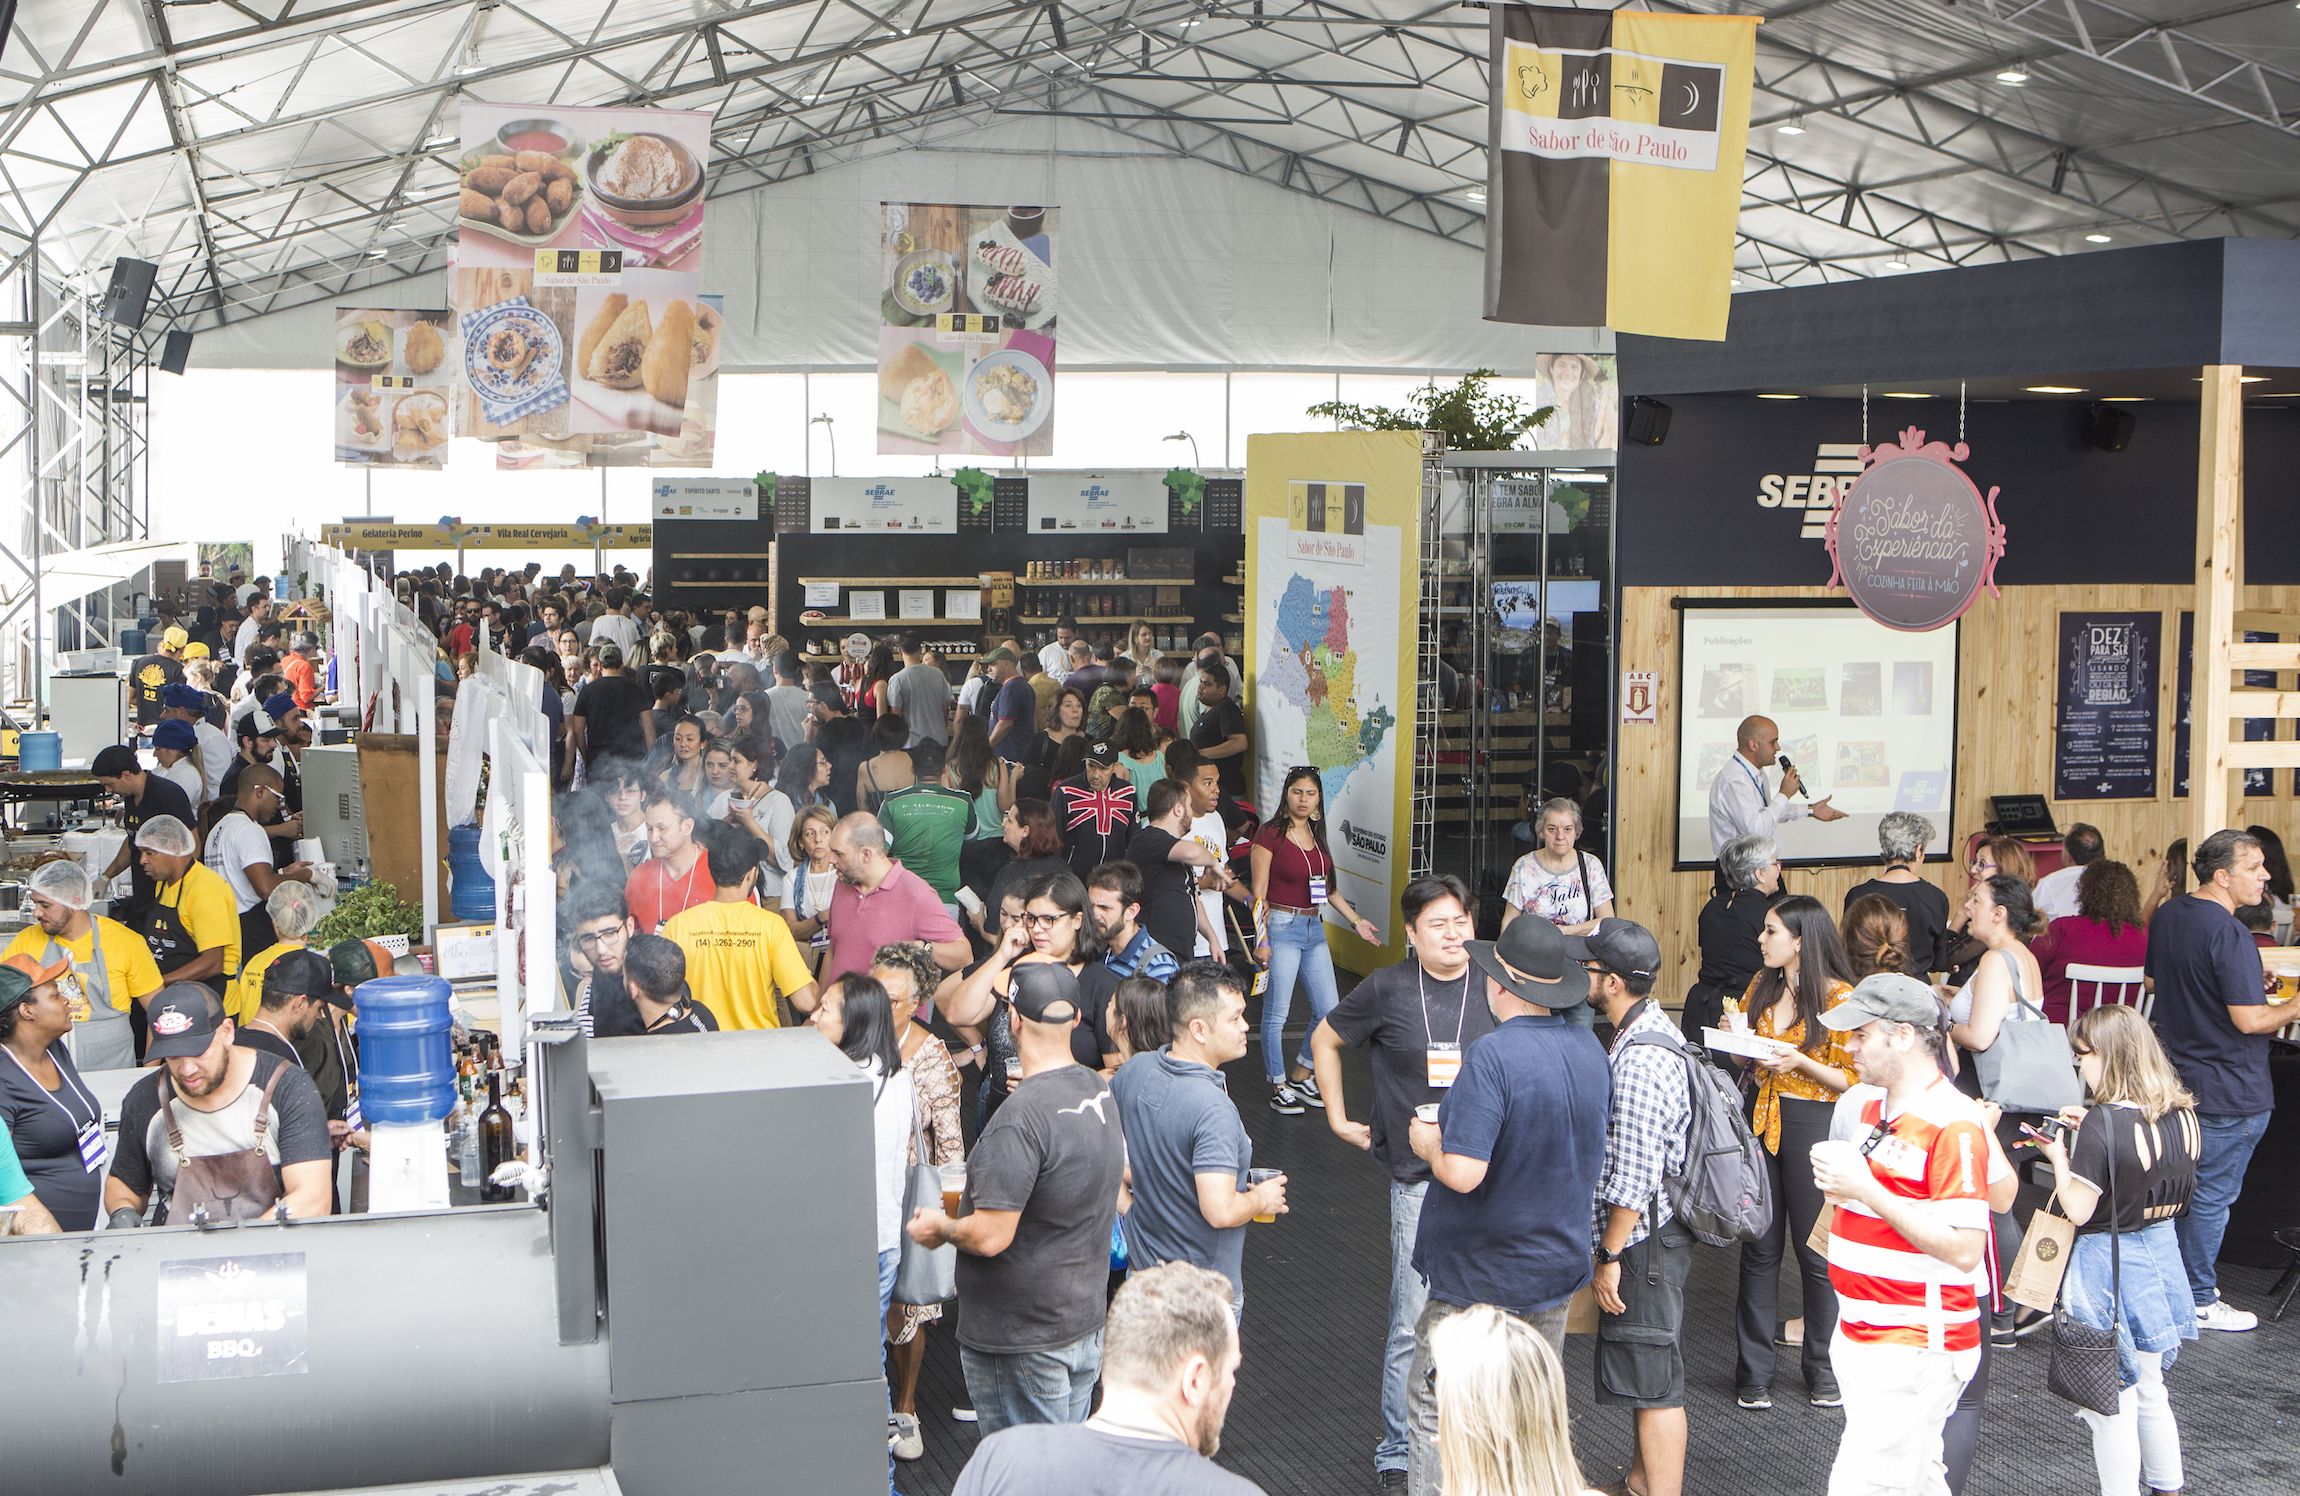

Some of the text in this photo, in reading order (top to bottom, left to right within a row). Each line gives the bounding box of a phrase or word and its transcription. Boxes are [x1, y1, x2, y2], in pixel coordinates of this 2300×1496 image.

[1528, 126, 1580, 151] Sabor
[1586, 127, 1605, 149] de
[1637, 134, 1688, 161] Paulo
[544, 275, 612, 284] Sabor de São Paulo
[1499, 484, 1516, 496] TEM
[1757, 474, 1858, 509] SEBR
[1514, 497, 1521, 508] A
[1870, 494, 1956, 540] Sabor da
[362, 529, 423, 538] Gelateria Perino
[497, 529, 568, 540] Vila Real Cervejaria
[1297, 538, 1355, 559] Sabor de São Paulo
[1854, 524, 1969, 570] Experiência
[1867, 574, 1905, 590] COZINHA
[1907, 576, 1926, 591] FEITA
[1934, 578, 1960, 594] MÃO
[1703, 636, 1753, 648] Publicações
[2091, 627, 2122, 645] DEZ
[2090, 645, 2129, 657] PARA SER
[2089, 664, 2127, 672] USANDO
[2143, 768, 2151, 776] 10
[1352, 833, 1386, 856] SÃO PAULO
[1549, 880, 1581, 906] Talk
[1558, 903, 1569, 916] is
[695, 938, 757, 949] (14) 3262-2901
[206, 1338, 263, 1360] BBQ
